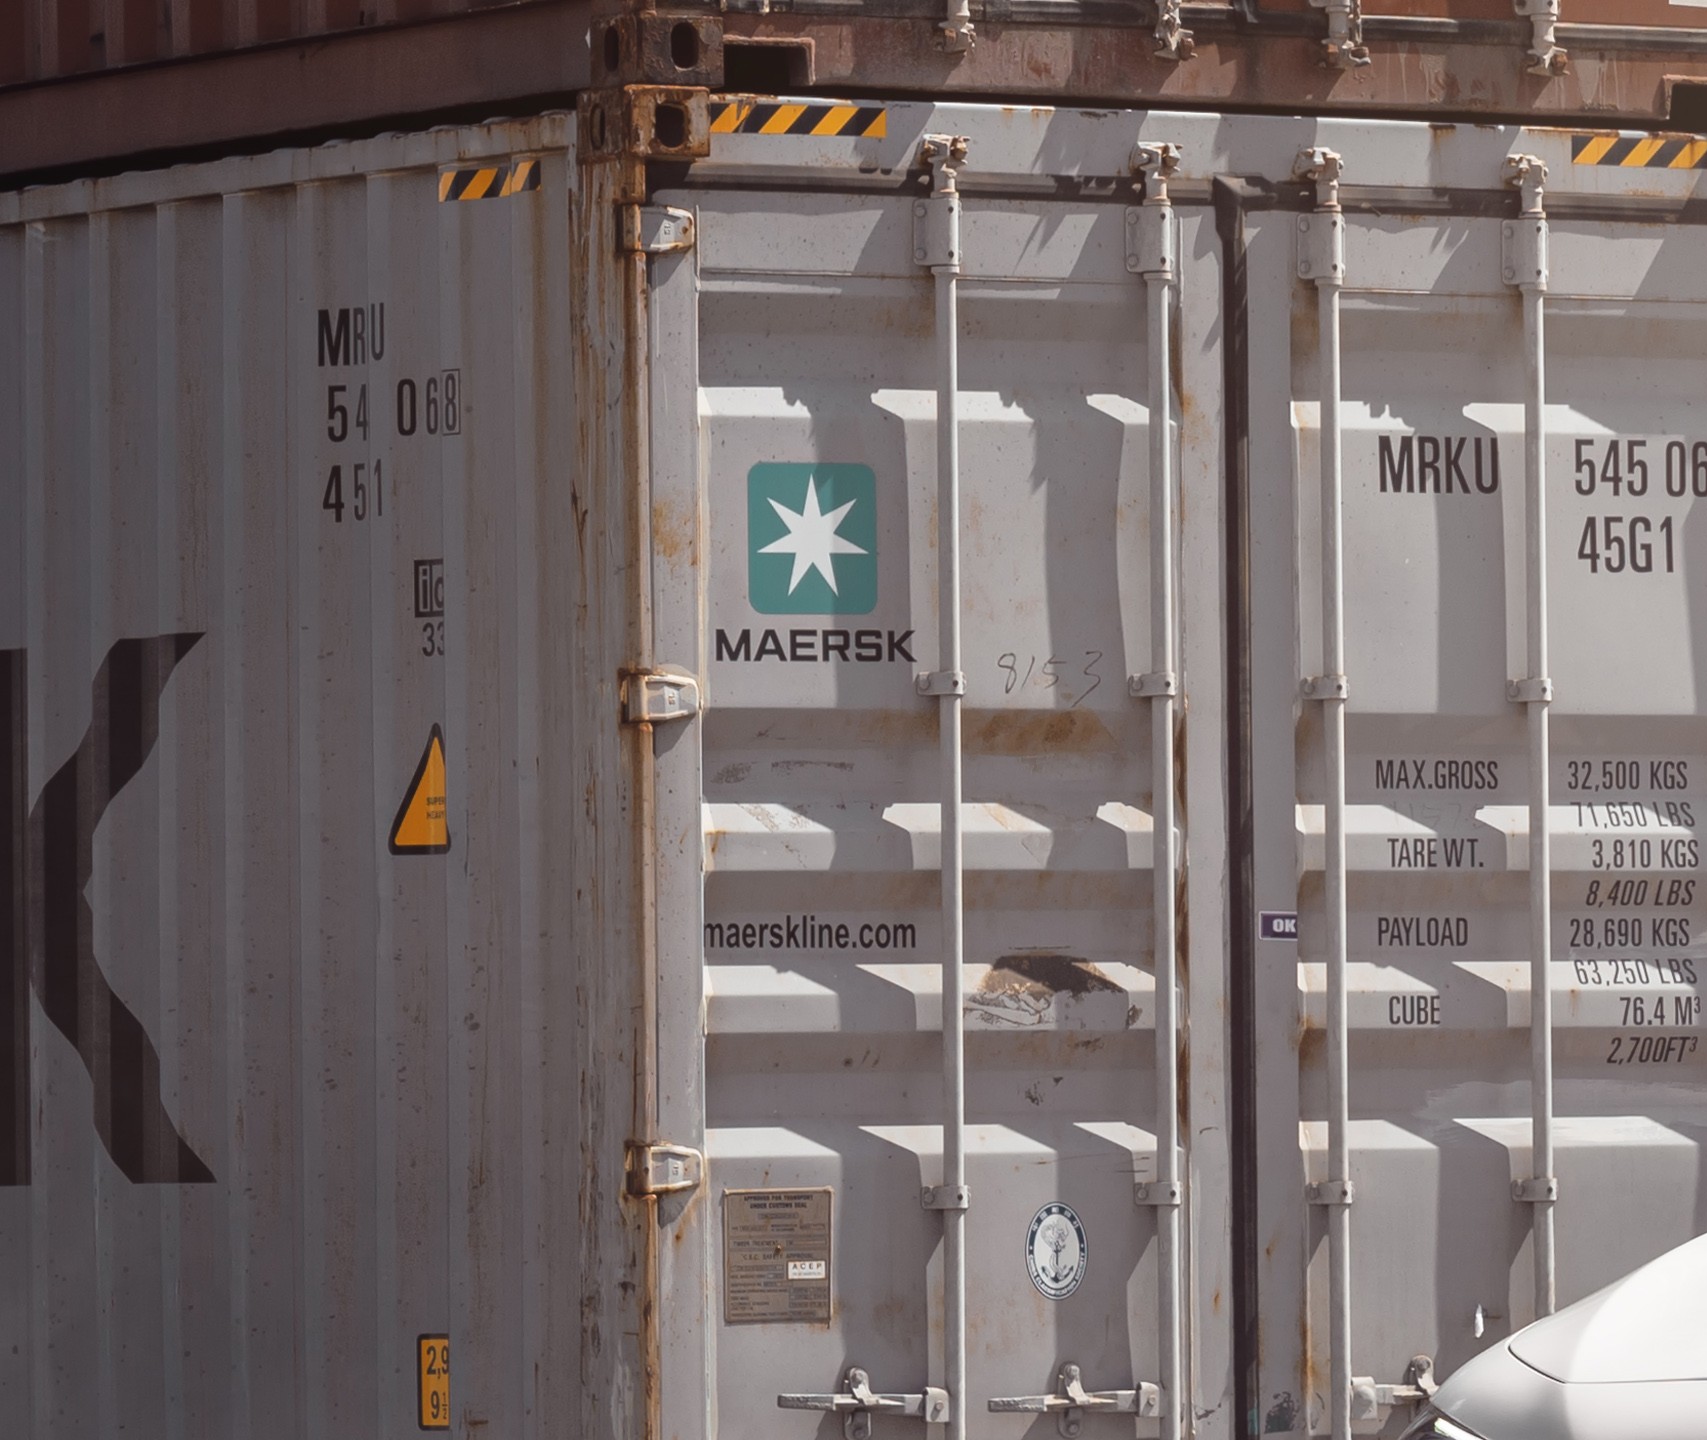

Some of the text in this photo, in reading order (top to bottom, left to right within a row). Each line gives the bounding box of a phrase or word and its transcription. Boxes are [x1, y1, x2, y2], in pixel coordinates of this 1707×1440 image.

[1379, 435, 1500, 495] MRKU
[1574, 440, 1648, 499] 545
[1577, 516, 1674, 574] 45G1
[714, 628, 916, 663] MAERSK
[1567, 759, 1641, 792] 32,500
[1649, 759, 1688, 791] KGS
[1571, 802, 1695, 829] 71,650 LBS
[1387, 838, 1699, 870] TARE WT. 3,810 KGS
[1586, 879, 1695, 909] 8,400 LBS
[704, 916, 916, 949] maerskline.com
[1272, 918, 1297, 933] OK
[1378, 916, 1690, 950] PAYLOAD 28,690 KGS
[1574, 959, 1697, 987] 63,250 LBS
[1388, 995, 1441, 1026] CUBE
[1619, 996, 1665, 1026] 76.4
